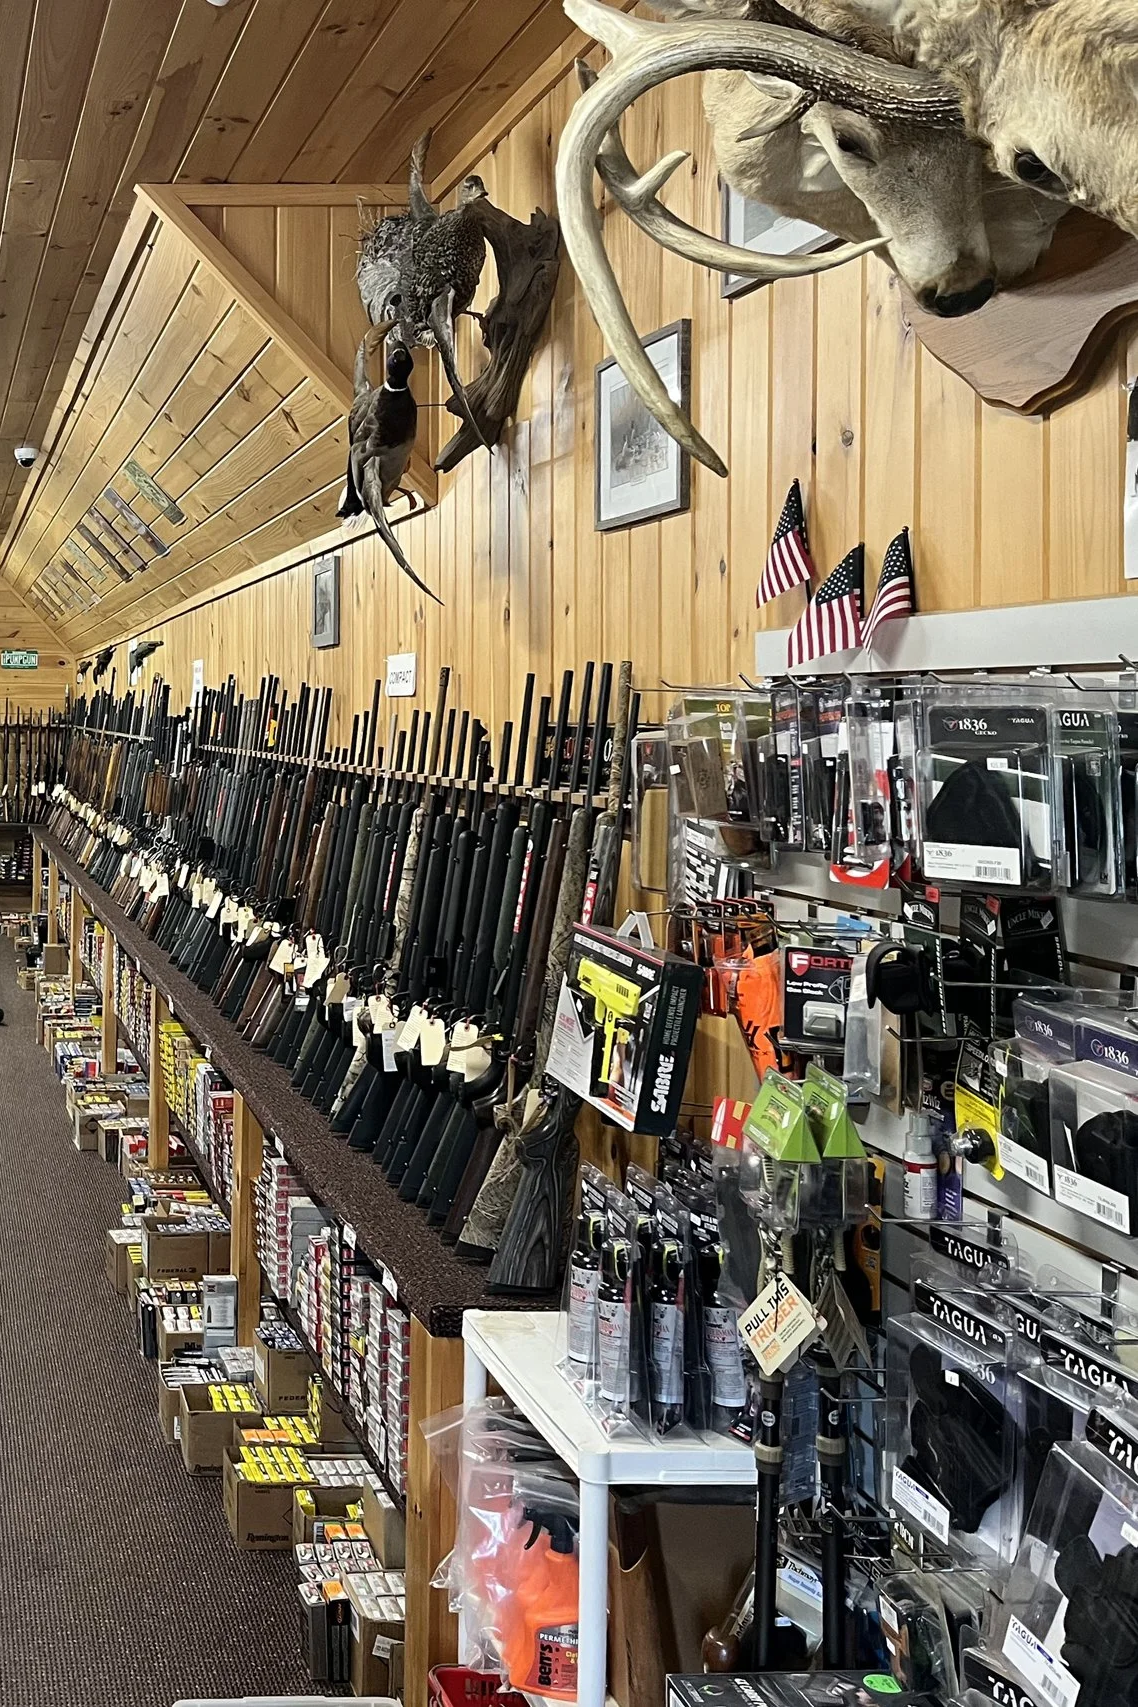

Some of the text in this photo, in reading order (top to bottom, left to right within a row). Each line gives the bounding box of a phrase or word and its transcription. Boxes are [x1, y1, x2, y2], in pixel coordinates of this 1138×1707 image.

[715, 703, 731, 714] TOP
[958, 718, 988, 732] 1836
[515, 855, 532, 929] SAVAGE
[803, 981, 828, 989] Profile
[1034, 1019, 1053, 1037] 1836
[1104, 1046, 1130, 1065] 1836
[650, 1053, 675, 1115] SABRE
[744, 1308, 770, 1337] PULL
[766, 1282, 790, 1312] THIS
[751, 1294, 799, 1348] TRIGGER
[929, 1296, 987, 1346] TAGUA
[1108, 1430, 1138, 1477] TA
[894, 1467, 916, 1491] TAGUA
[1011, 1618, 1037, 1650] TAGUA
[537, 1643, 554, 1687] Ben's
